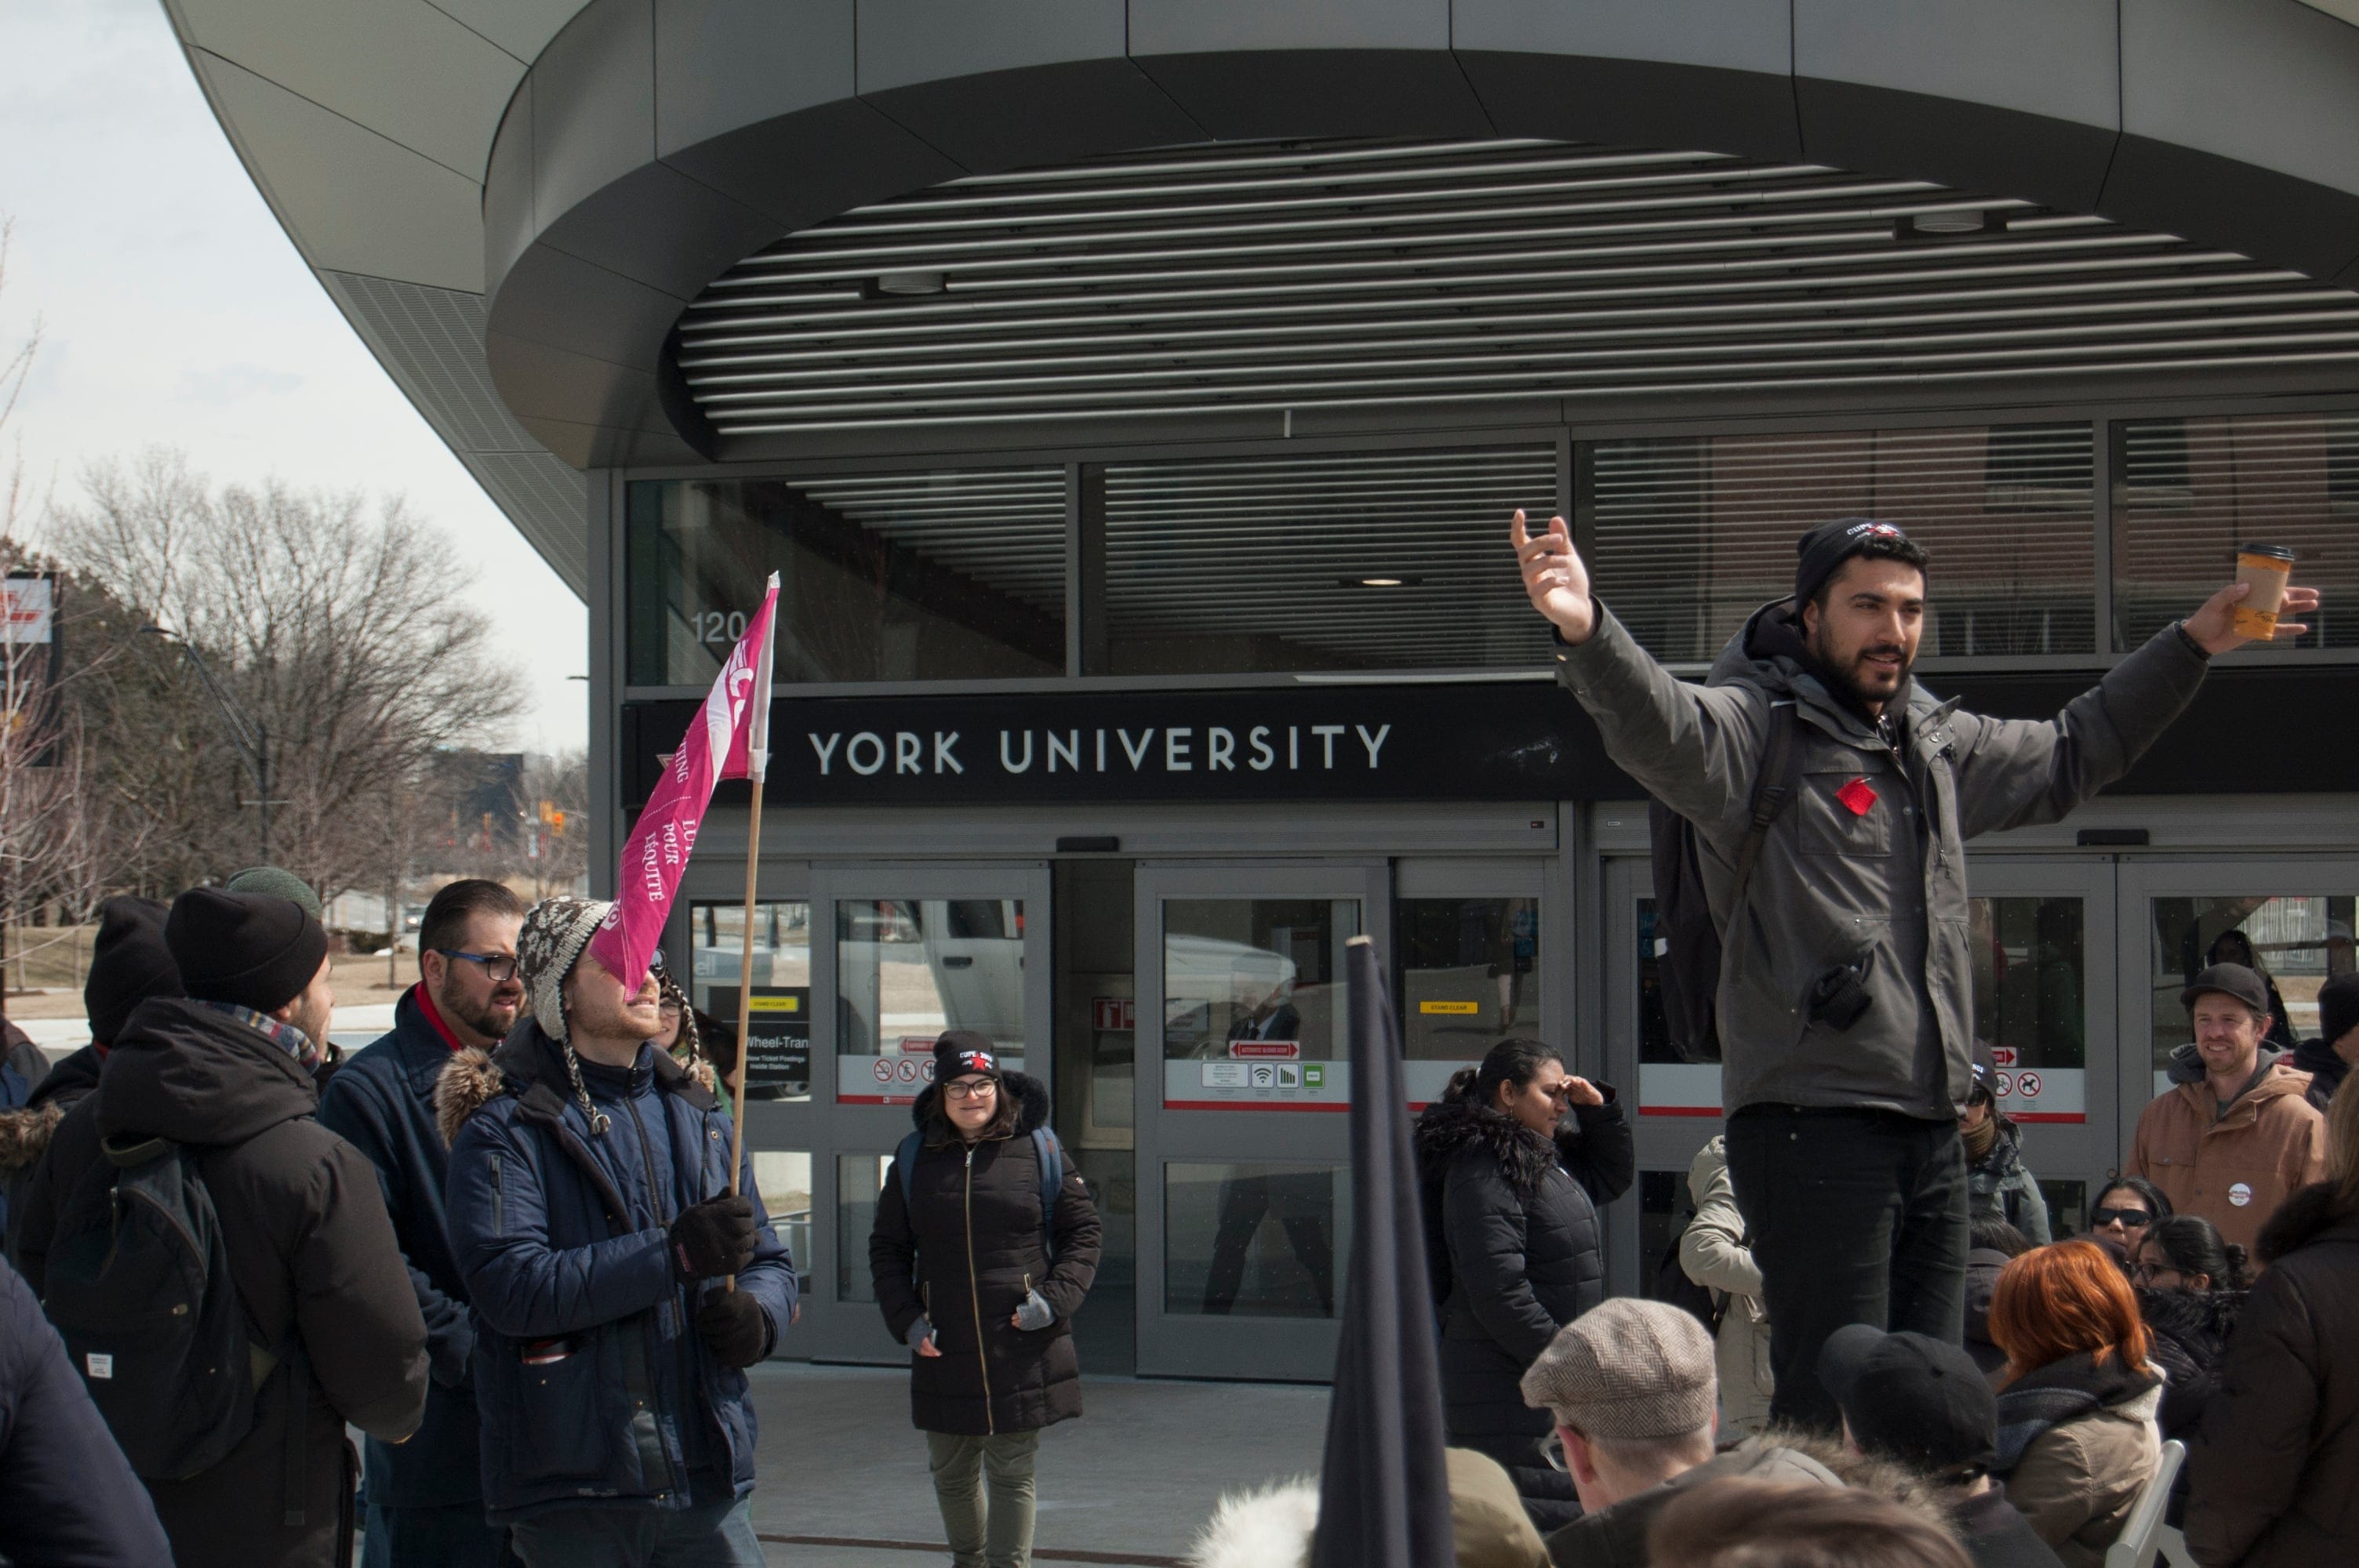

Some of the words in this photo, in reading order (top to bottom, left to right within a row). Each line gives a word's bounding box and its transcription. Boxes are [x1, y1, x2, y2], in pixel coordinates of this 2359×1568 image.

[691, 612, 747, 642] 120
[809, 731, 963, 775] YORK
[1000, 725, 1390, 775] UNIVERSITY
[663, 822, 678, 865] POUR
